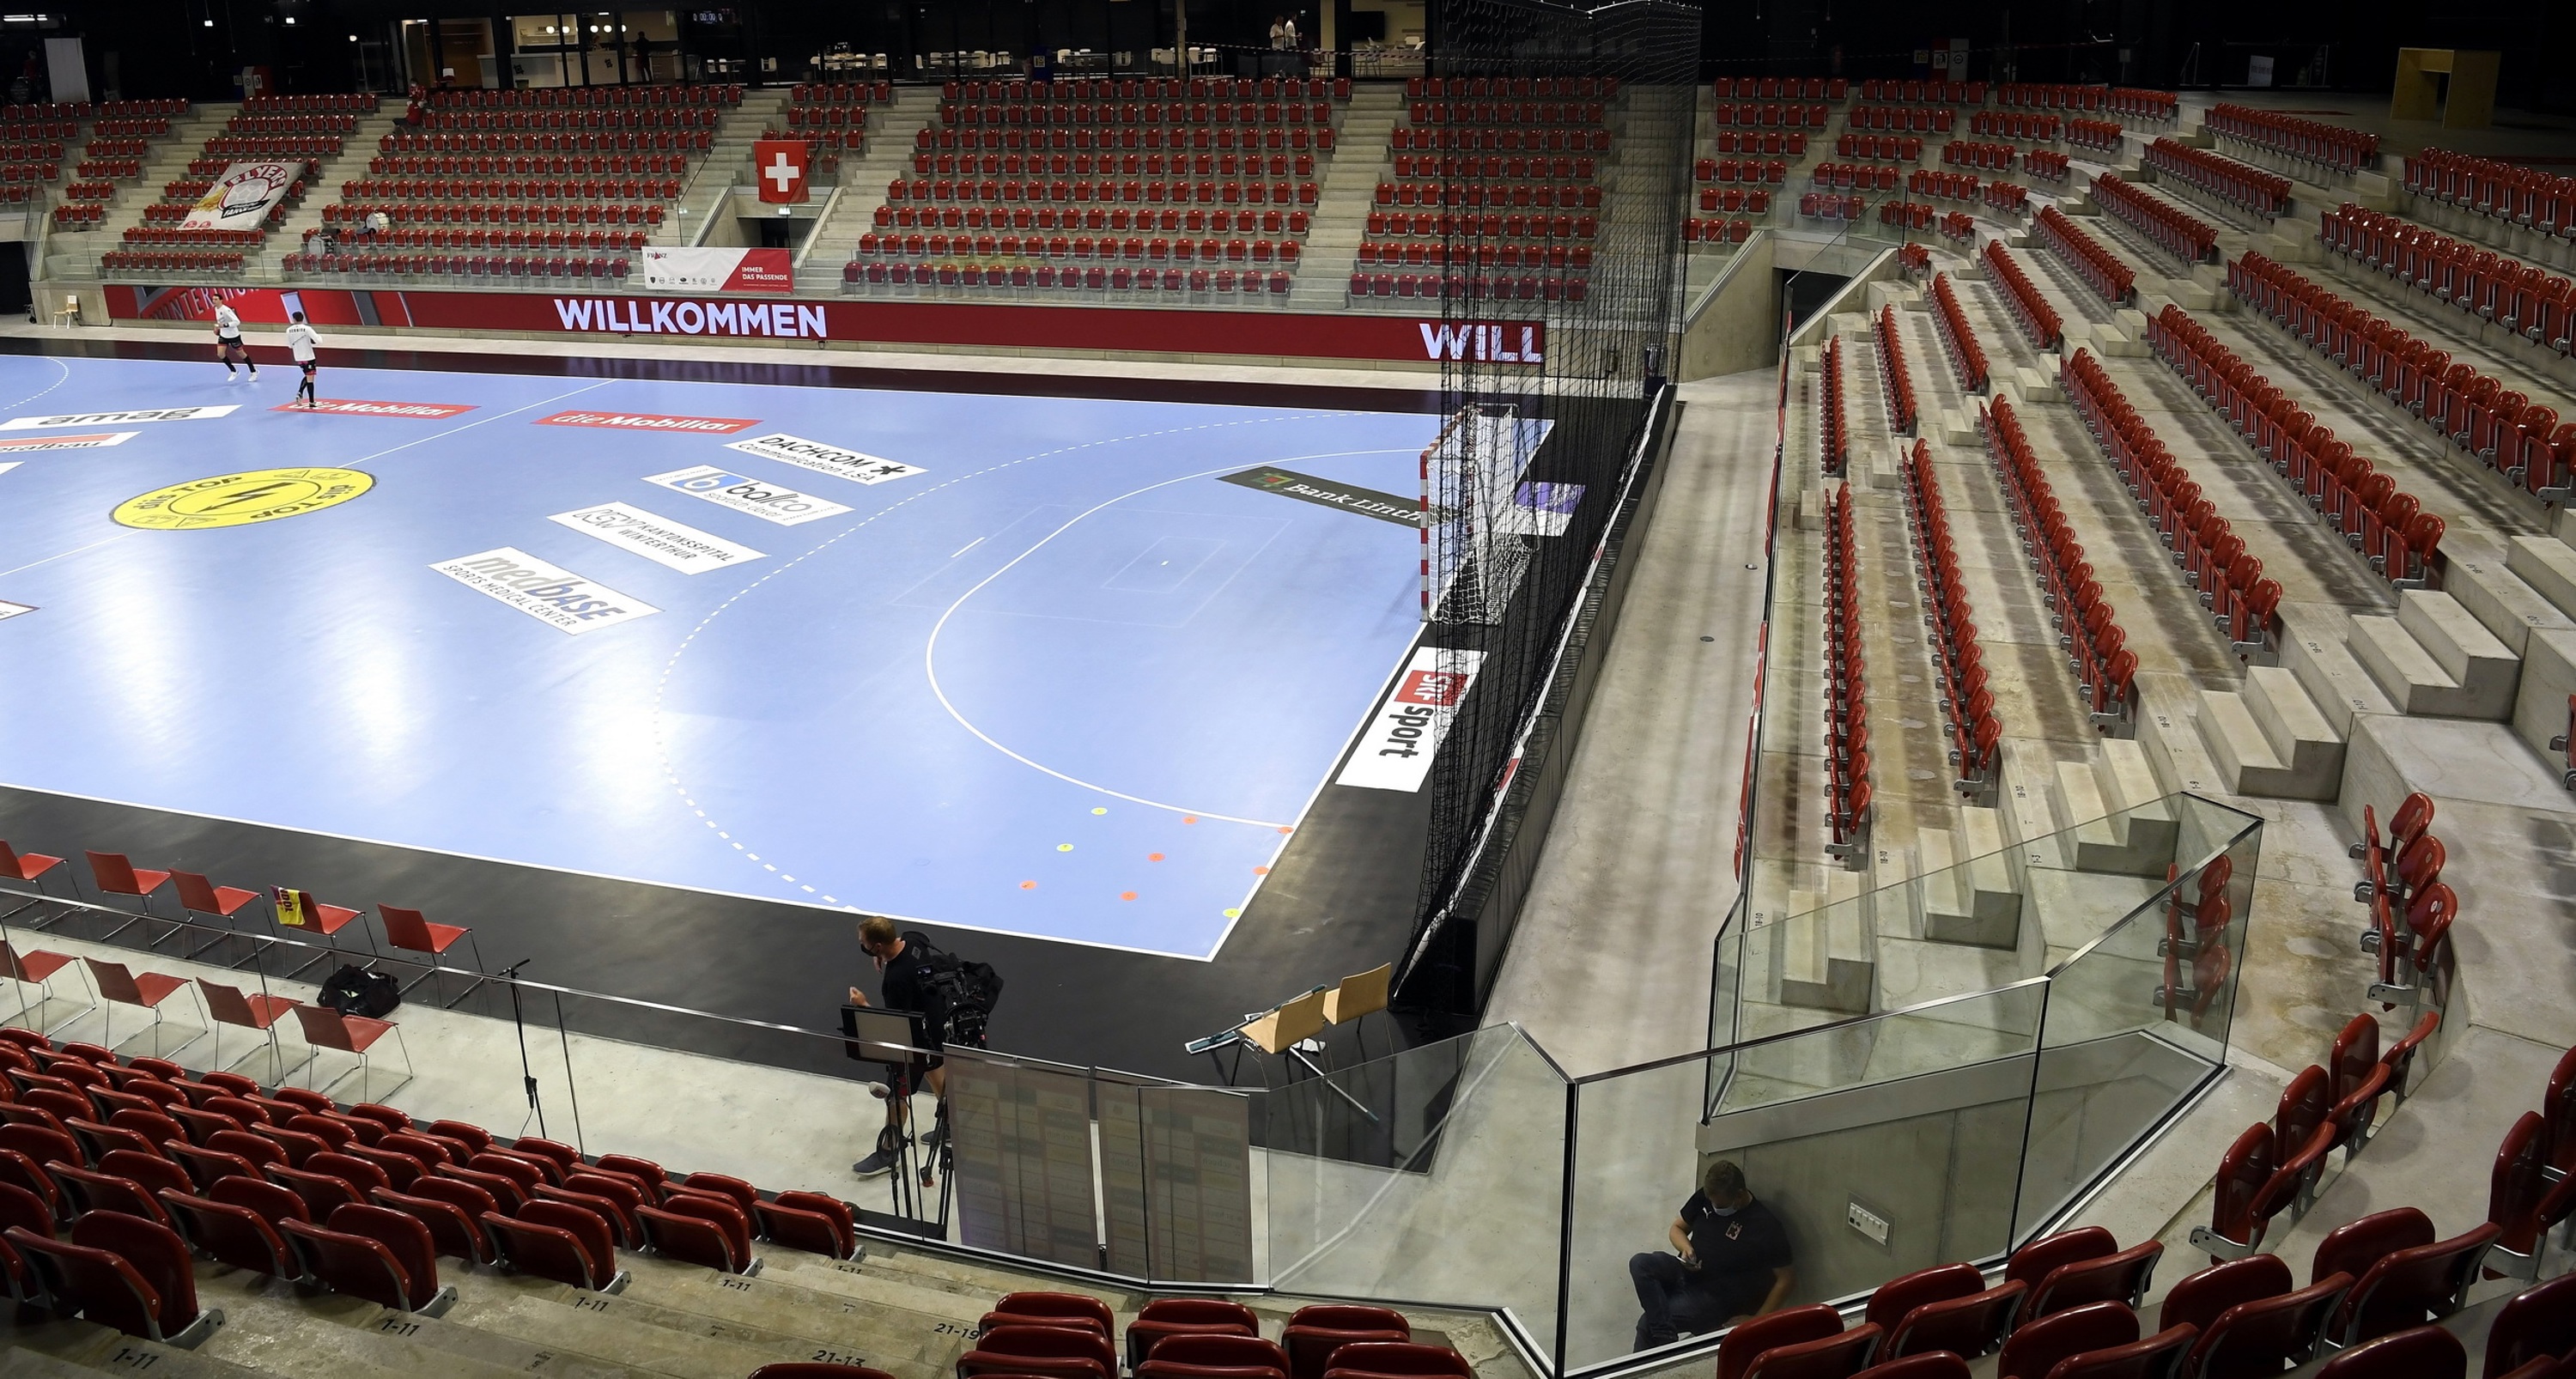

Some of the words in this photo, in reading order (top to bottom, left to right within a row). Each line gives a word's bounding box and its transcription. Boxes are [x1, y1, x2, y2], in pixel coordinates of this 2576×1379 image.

[229, 165, 287, 188] FLYERS
[554, 298, 828, 337] WILLKOMMEN
[1419, 322, 1544, 362] WILL
[38, 408, 203, 426] amag
[329, 402, 456, 419] Mobiliar
[552, 412, 606, 424] die
[603, 415, 742, 433] Mobiliar
[738, 442, 842, 474] Communication
[840, 470, 878, 483] LSA
[757, 436, 875, 470] DACHCOM
[172, 477, 242, 492] TOP
[726, 482, 813, 513] ballco
[1283, 483, 1355, 505] Bank
[1348, 498, 1421, 523] Linth
[250, 501, 324, 519] TOP
[618, 527, 699, 561] WINTERTHUR
[637, 523, 736, 562] KANTONSSPITAL
[443, 564, 483, 586] SPORTS
[481, 581, 531, 609] MEDICAL
[524, 601, 578, 629] CENTER
[1379, 706, 1434, 758] sport
[721, 1279, 752, 1292] 1-11
[575, 1296, 609, 1312] 1-11
[380, 1318, 421, 1338] 1-11
[933, 1322, 981, 1341] 21-19
[112, 1347, 161, 1371] 1-11
[811, 1349, 867, 1370] 21-13
